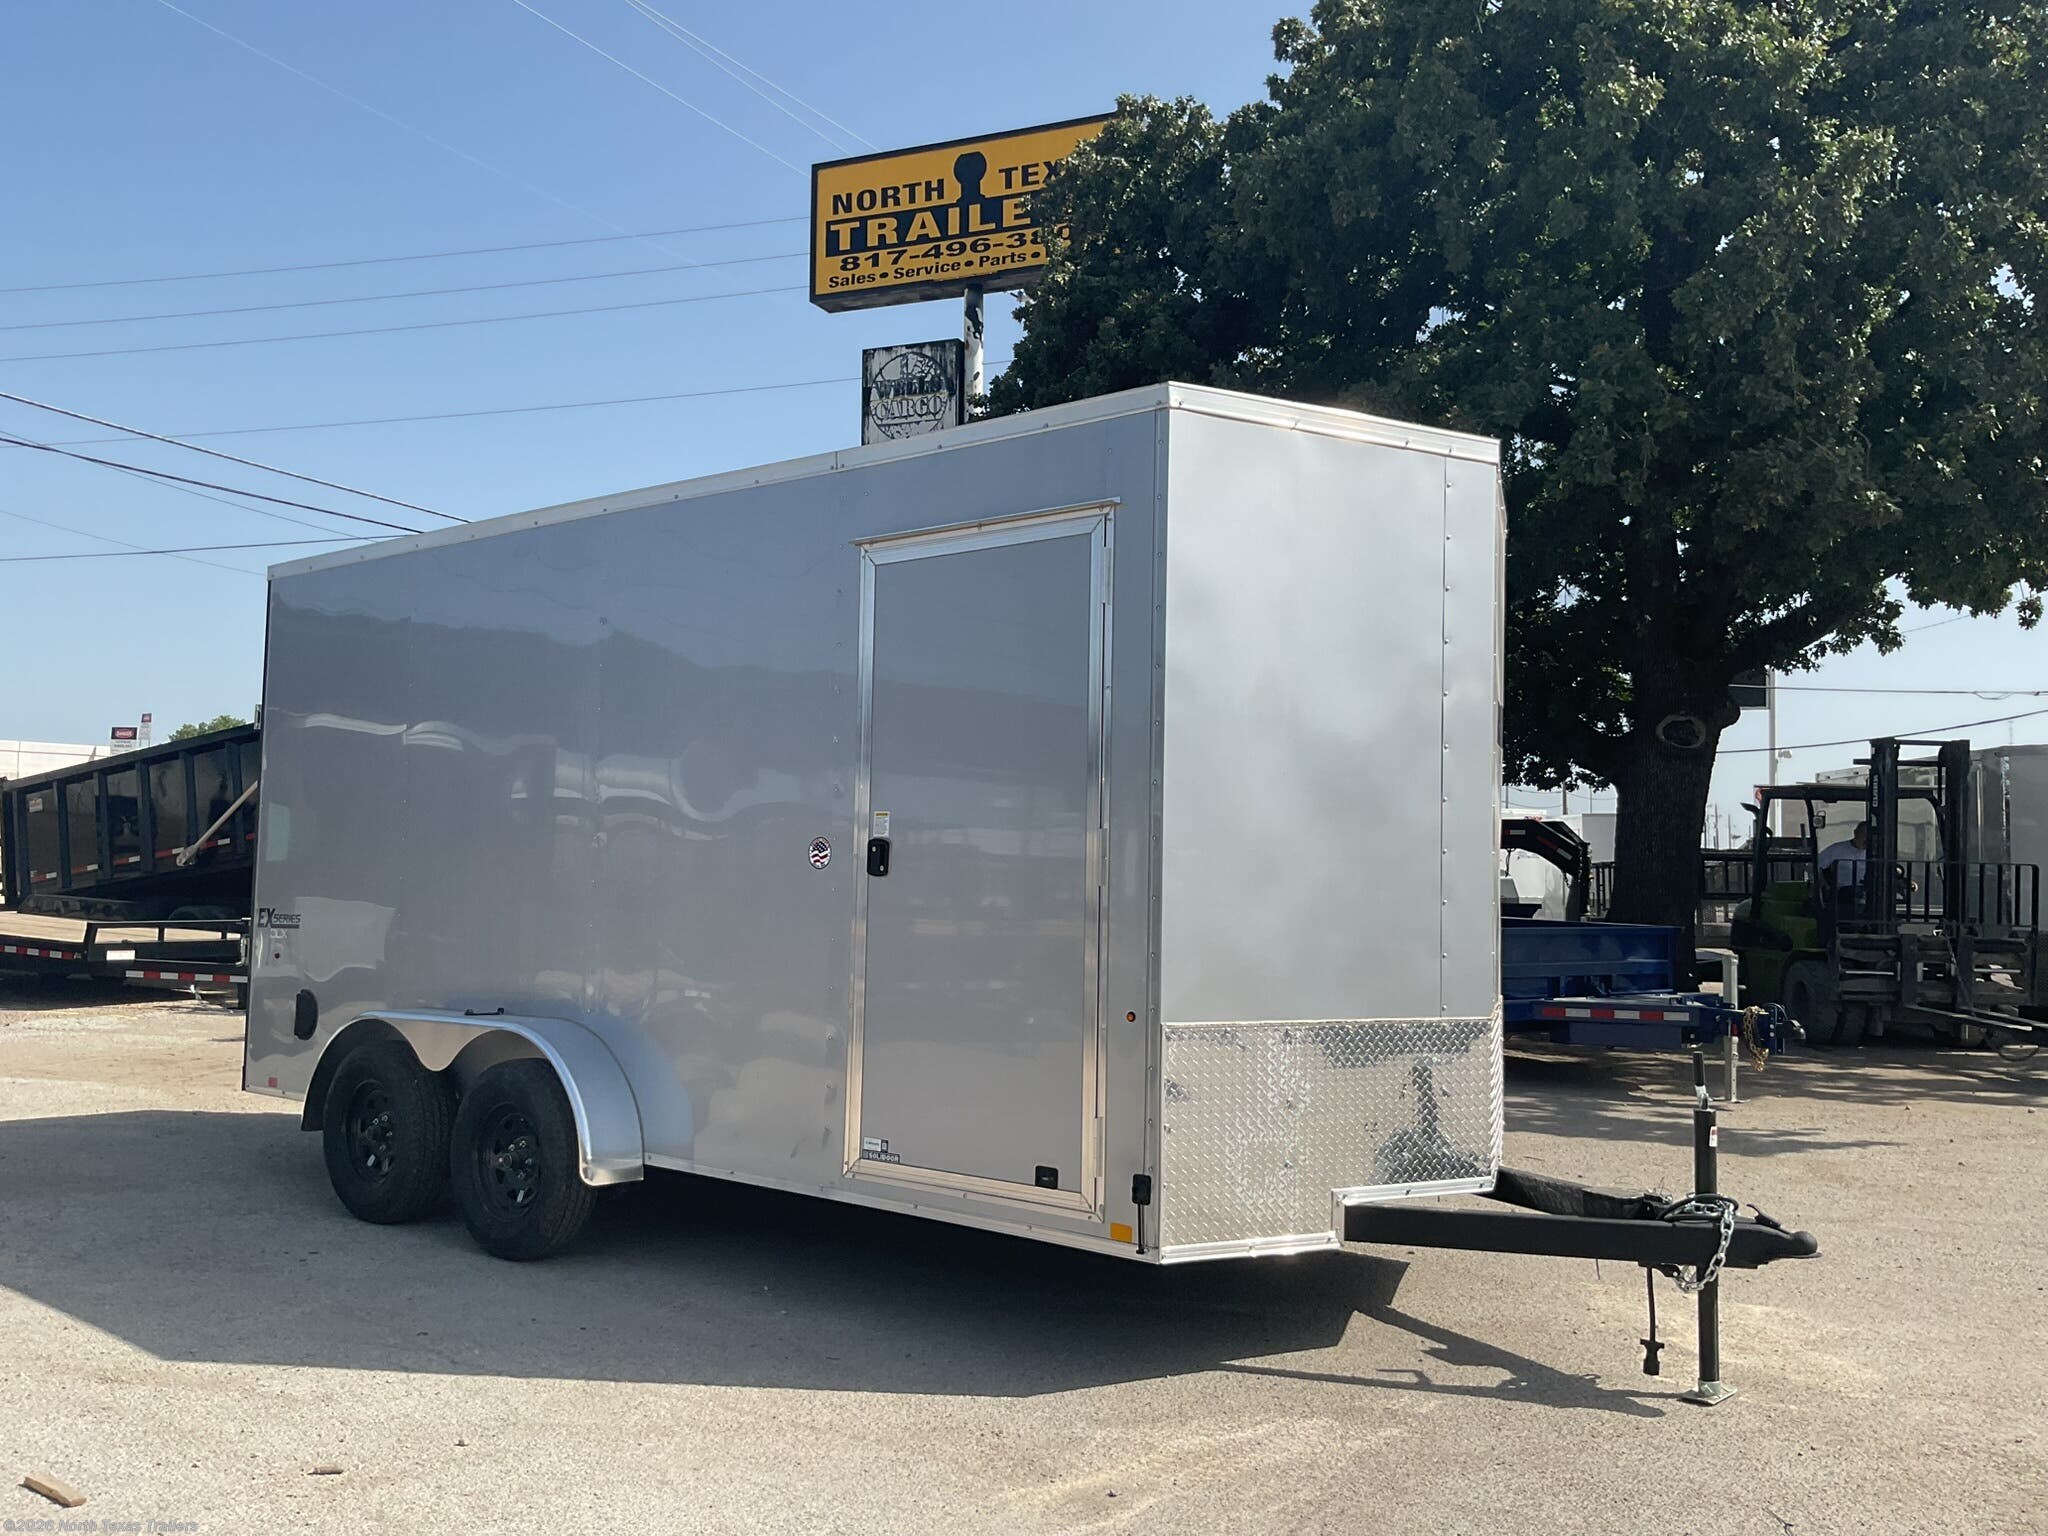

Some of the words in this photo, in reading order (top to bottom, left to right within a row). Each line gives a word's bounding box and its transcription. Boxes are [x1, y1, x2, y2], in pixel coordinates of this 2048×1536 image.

[832, 178, 945, 215] NORTH
[998, 160, 1065, 190] TEX
[830, 198, 1031, 251] TRAILE
[828, 273, 876, 288] Sales
[893, 261, 961, 280] Service
[979, 251, 1027, 268] Parts
[875, 395, 943, 421] CARGO
